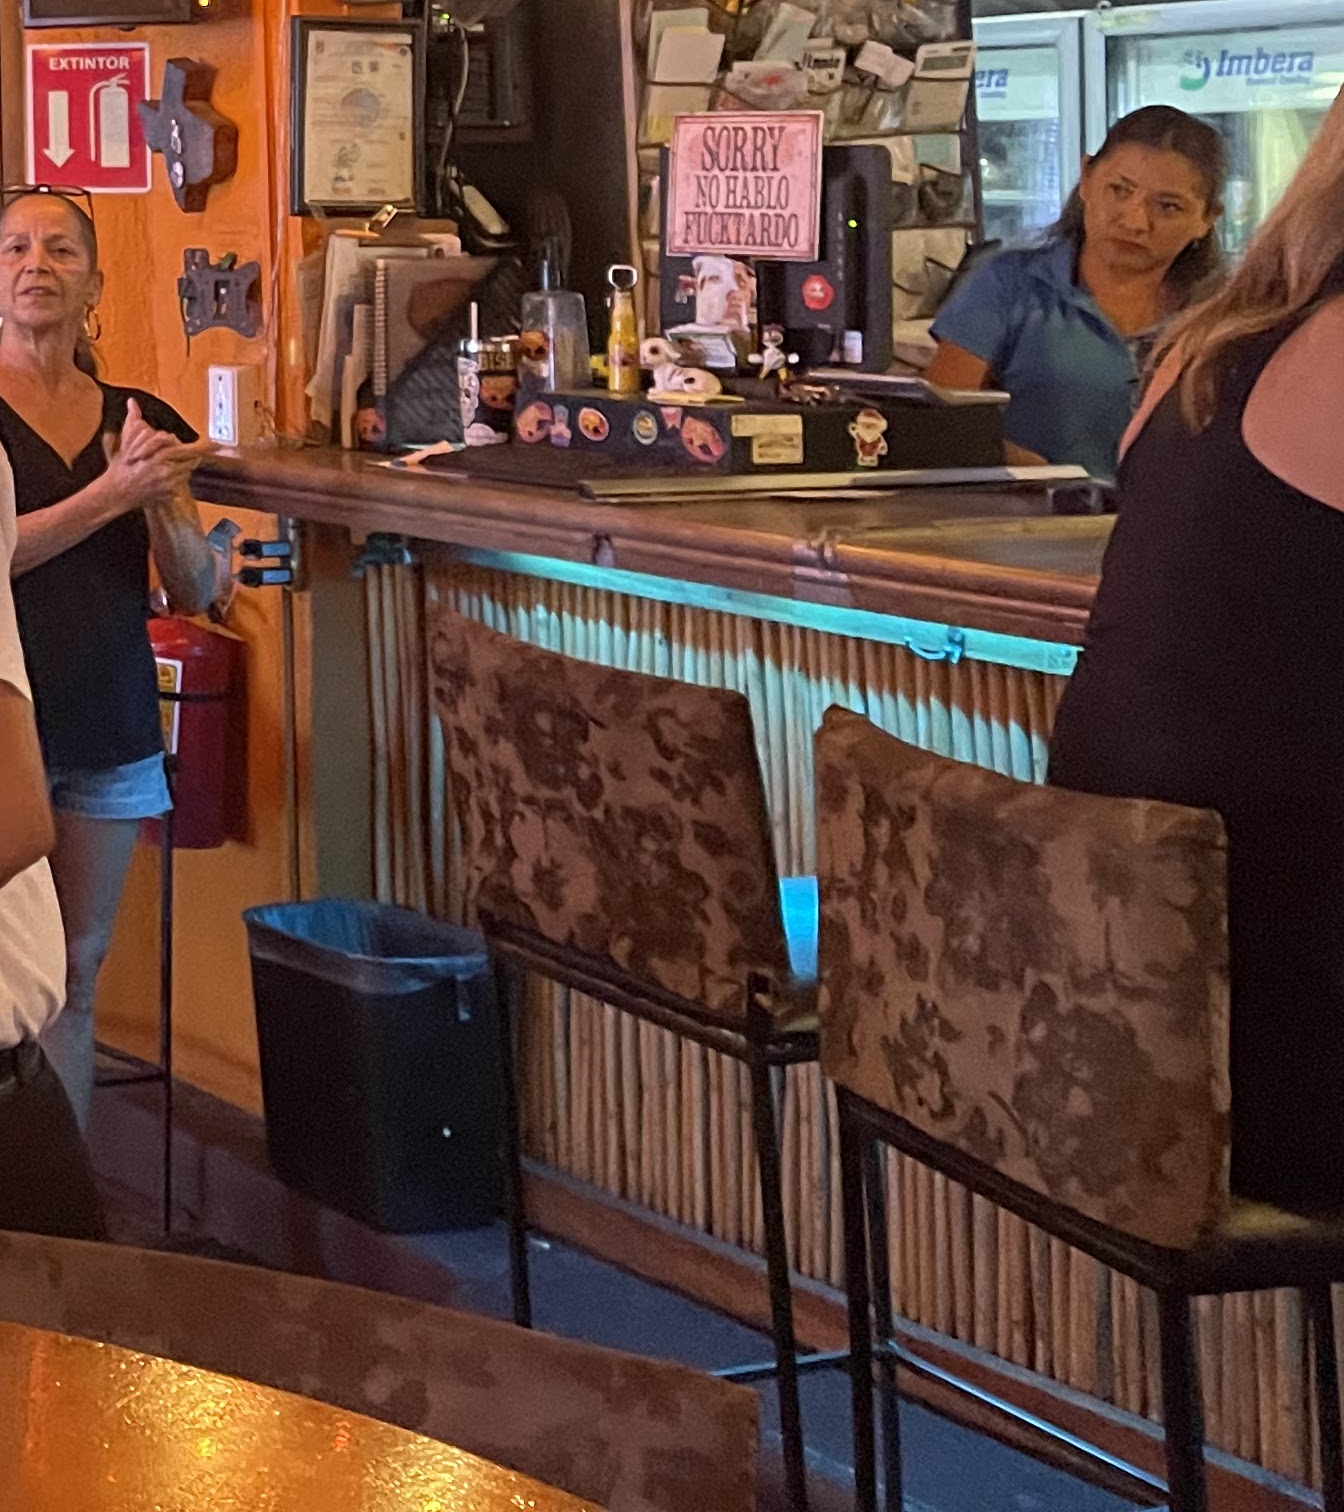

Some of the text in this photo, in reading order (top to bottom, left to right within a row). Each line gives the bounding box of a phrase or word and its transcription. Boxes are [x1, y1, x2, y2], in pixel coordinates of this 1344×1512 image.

[49, 55, 130, 73] EXTINTOR
[975, 67, 1009, 89] era
[1215, 50, 1314, 76] Imbera
[700, 125, 787, 173] SORRY
[694, 174, 790, 210] NO HABLO
[683, 211, 800, 249] FUCKTARDO
